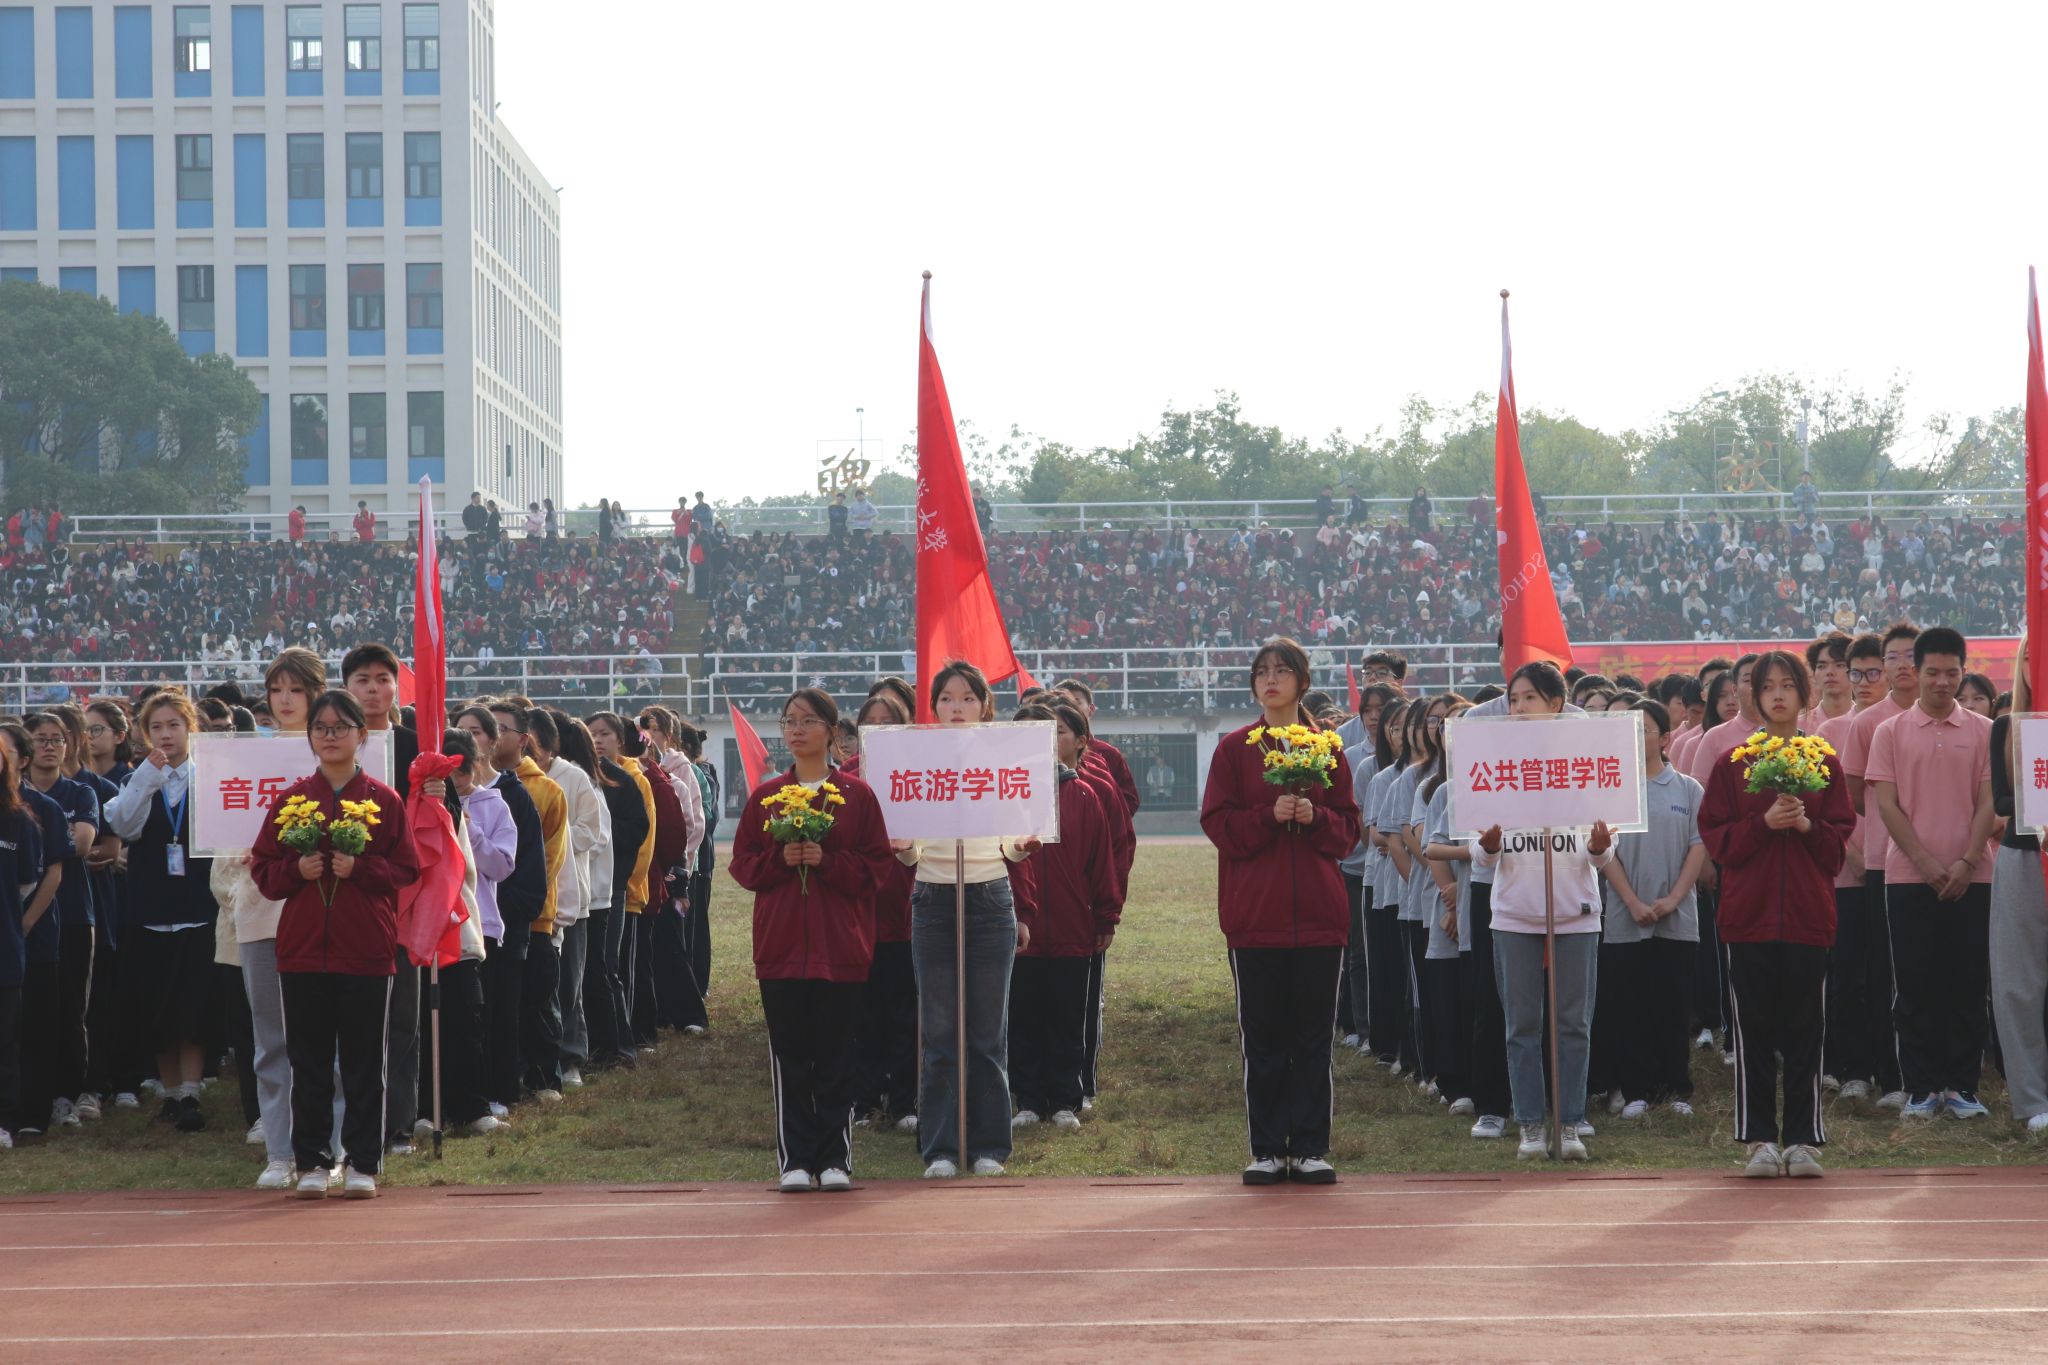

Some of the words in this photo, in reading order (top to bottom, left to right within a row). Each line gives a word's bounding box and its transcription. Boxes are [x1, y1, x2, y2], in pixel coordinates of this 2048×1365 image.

[890, 767, 1031, 802] 旅游学院
[1469, 756, 1621, 792] 公共管理学院
[219, 777, 313, 810] 音乐
